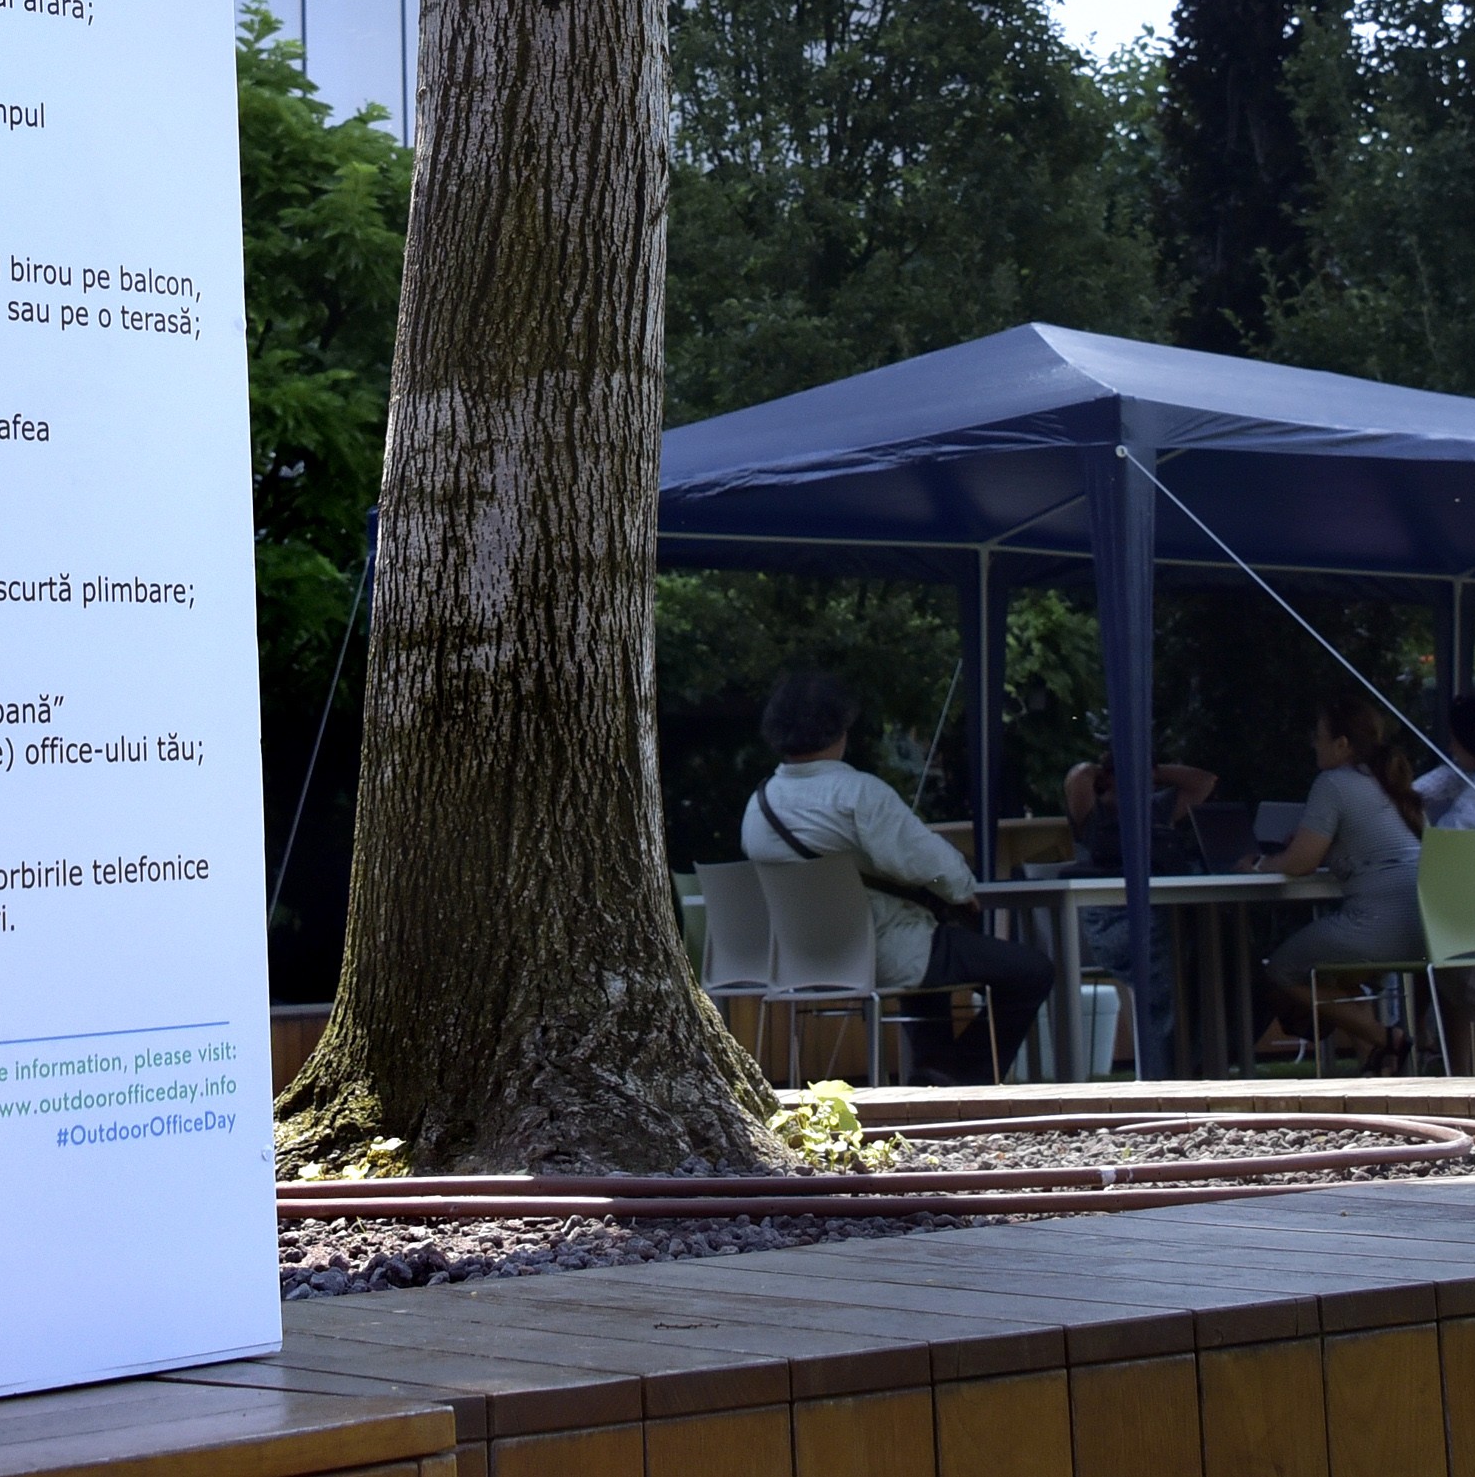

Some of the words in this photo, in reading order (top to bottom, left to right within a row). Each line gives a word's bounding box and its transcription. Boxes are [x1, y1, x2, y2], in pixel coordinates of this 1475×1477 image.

[10, 254, 72, 287] birou
[82, 267, 111, 295] pe
[119, 264, 201, 304] balcon,
[7, 300, 50, 324] sau
[60, 304, 89, 332] pe
[97, 307, 112, 329] o
[120, 304, 201, 342] terasă;
[82, 574, 195, 610] plimbare;
[25, 734, 148, 766] office-ului
[156, 731, 204, 767] tău;
[91, 853, 210, 886] telefonice
[15, 1052, 128, 1081] information,
[134, 1047, 192, 1075] please
[197, 1041, 237, 1063] visit:
[56, 1110, 237, 1148] #OutdoorOfficeDay
